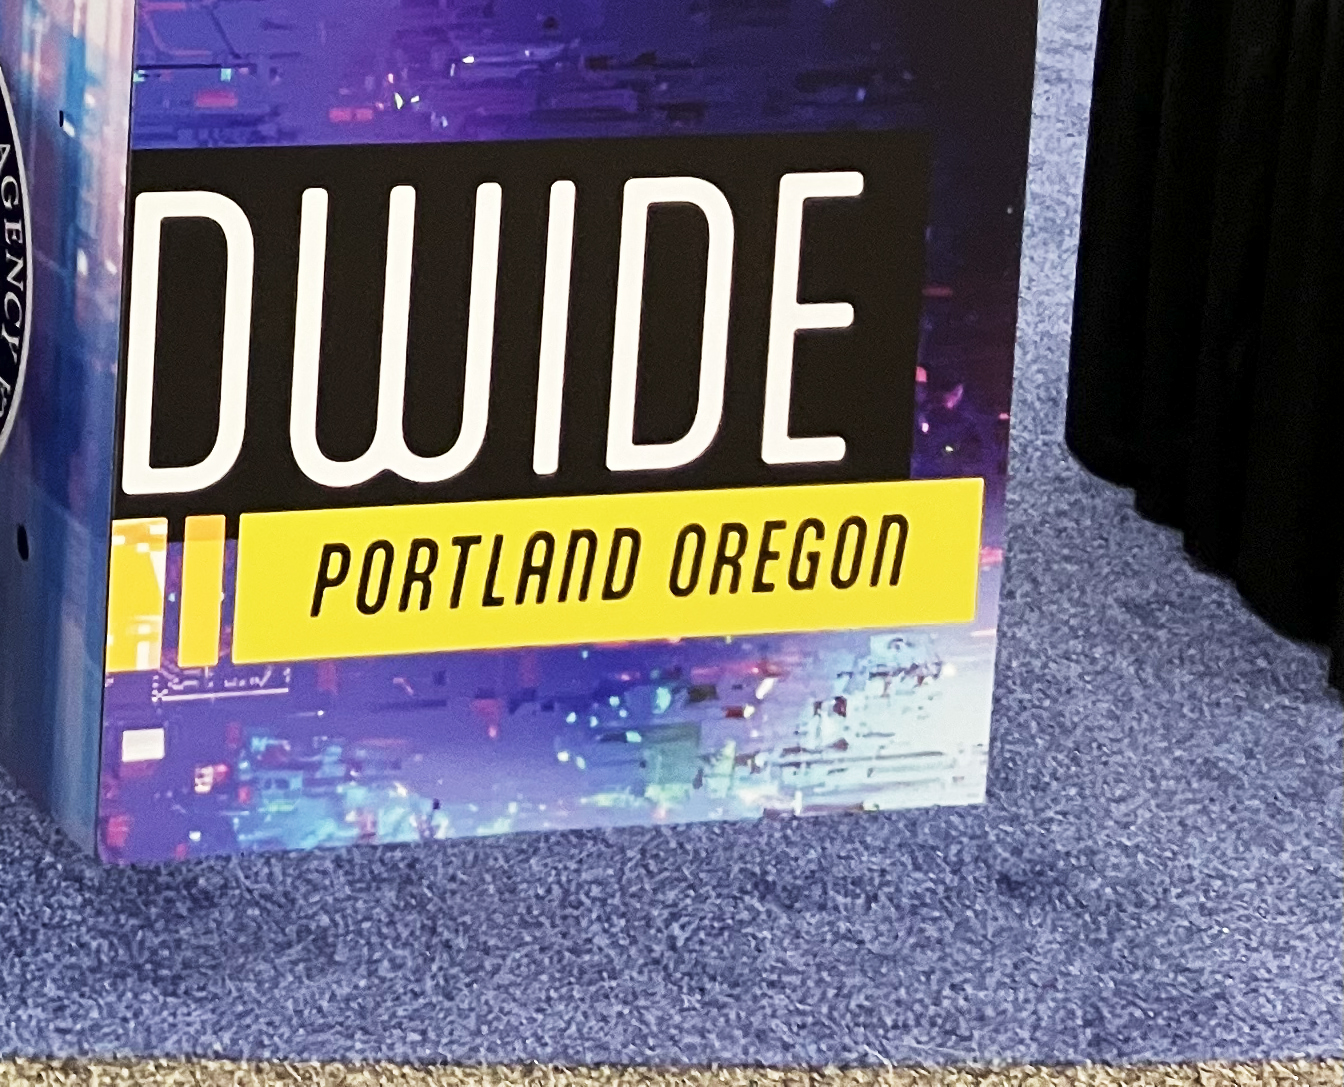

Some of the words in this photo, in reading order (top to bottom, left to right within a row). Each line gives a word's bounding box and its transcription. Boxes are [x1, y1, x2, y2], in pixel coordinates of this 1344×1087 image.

[119, 170, 865, 496] DWIDE
[310, 527, 642, 619] PORTLAND
[668, 513, 910, 599] OREGON
